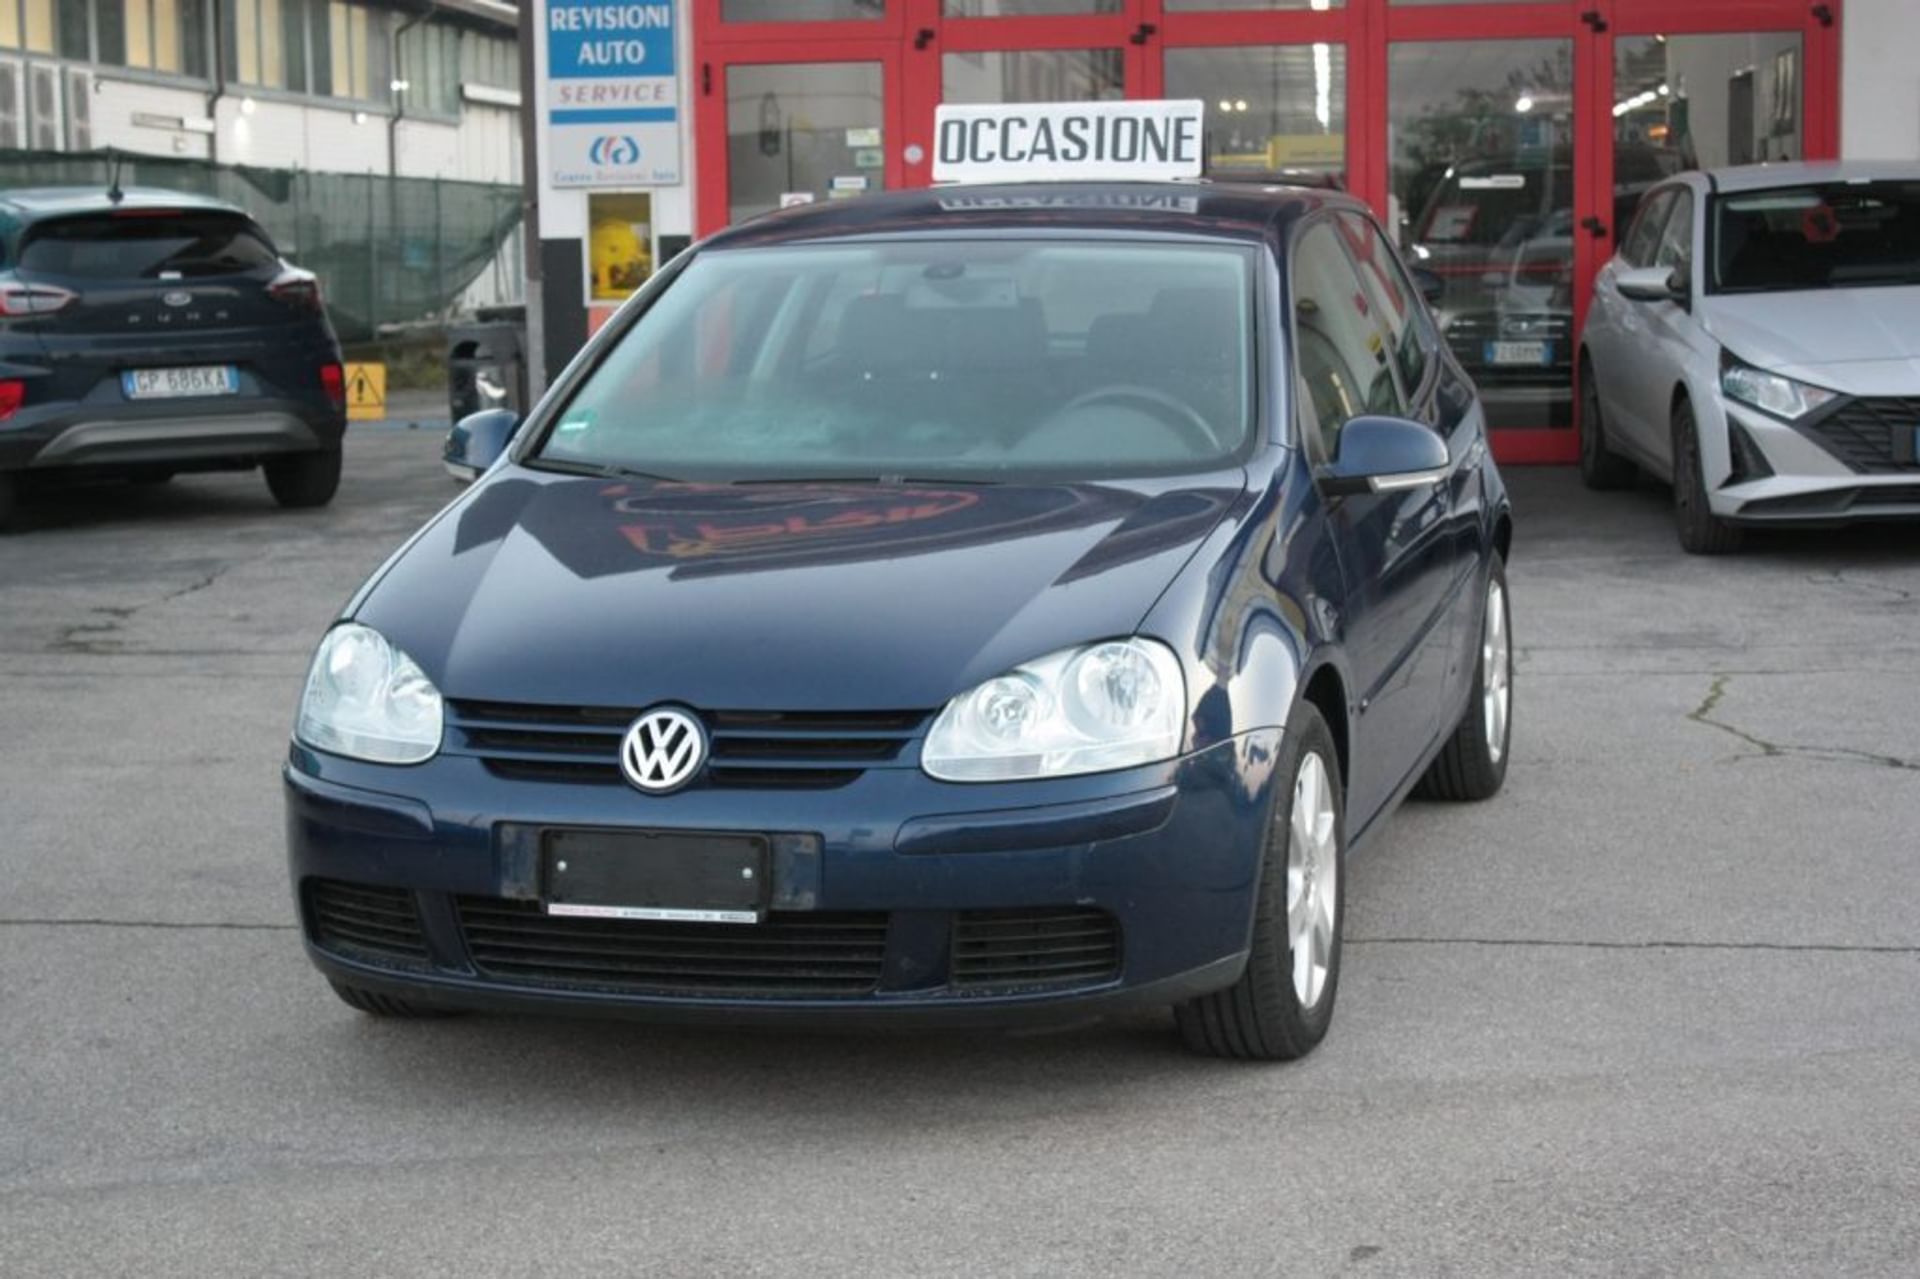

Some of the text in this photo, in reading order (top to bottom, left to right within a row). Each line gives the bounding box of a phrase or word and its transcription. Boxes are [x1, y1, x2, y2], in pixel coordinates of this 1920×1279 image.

[550, 5, 670, 31] REVISIONI
[577, 39, 646, 66] AUTO
[559, 83, 667, 104] SERVICE
[938, 116, 1197, 164] OCCASIONE
[624, 712, 699, 787] VW
